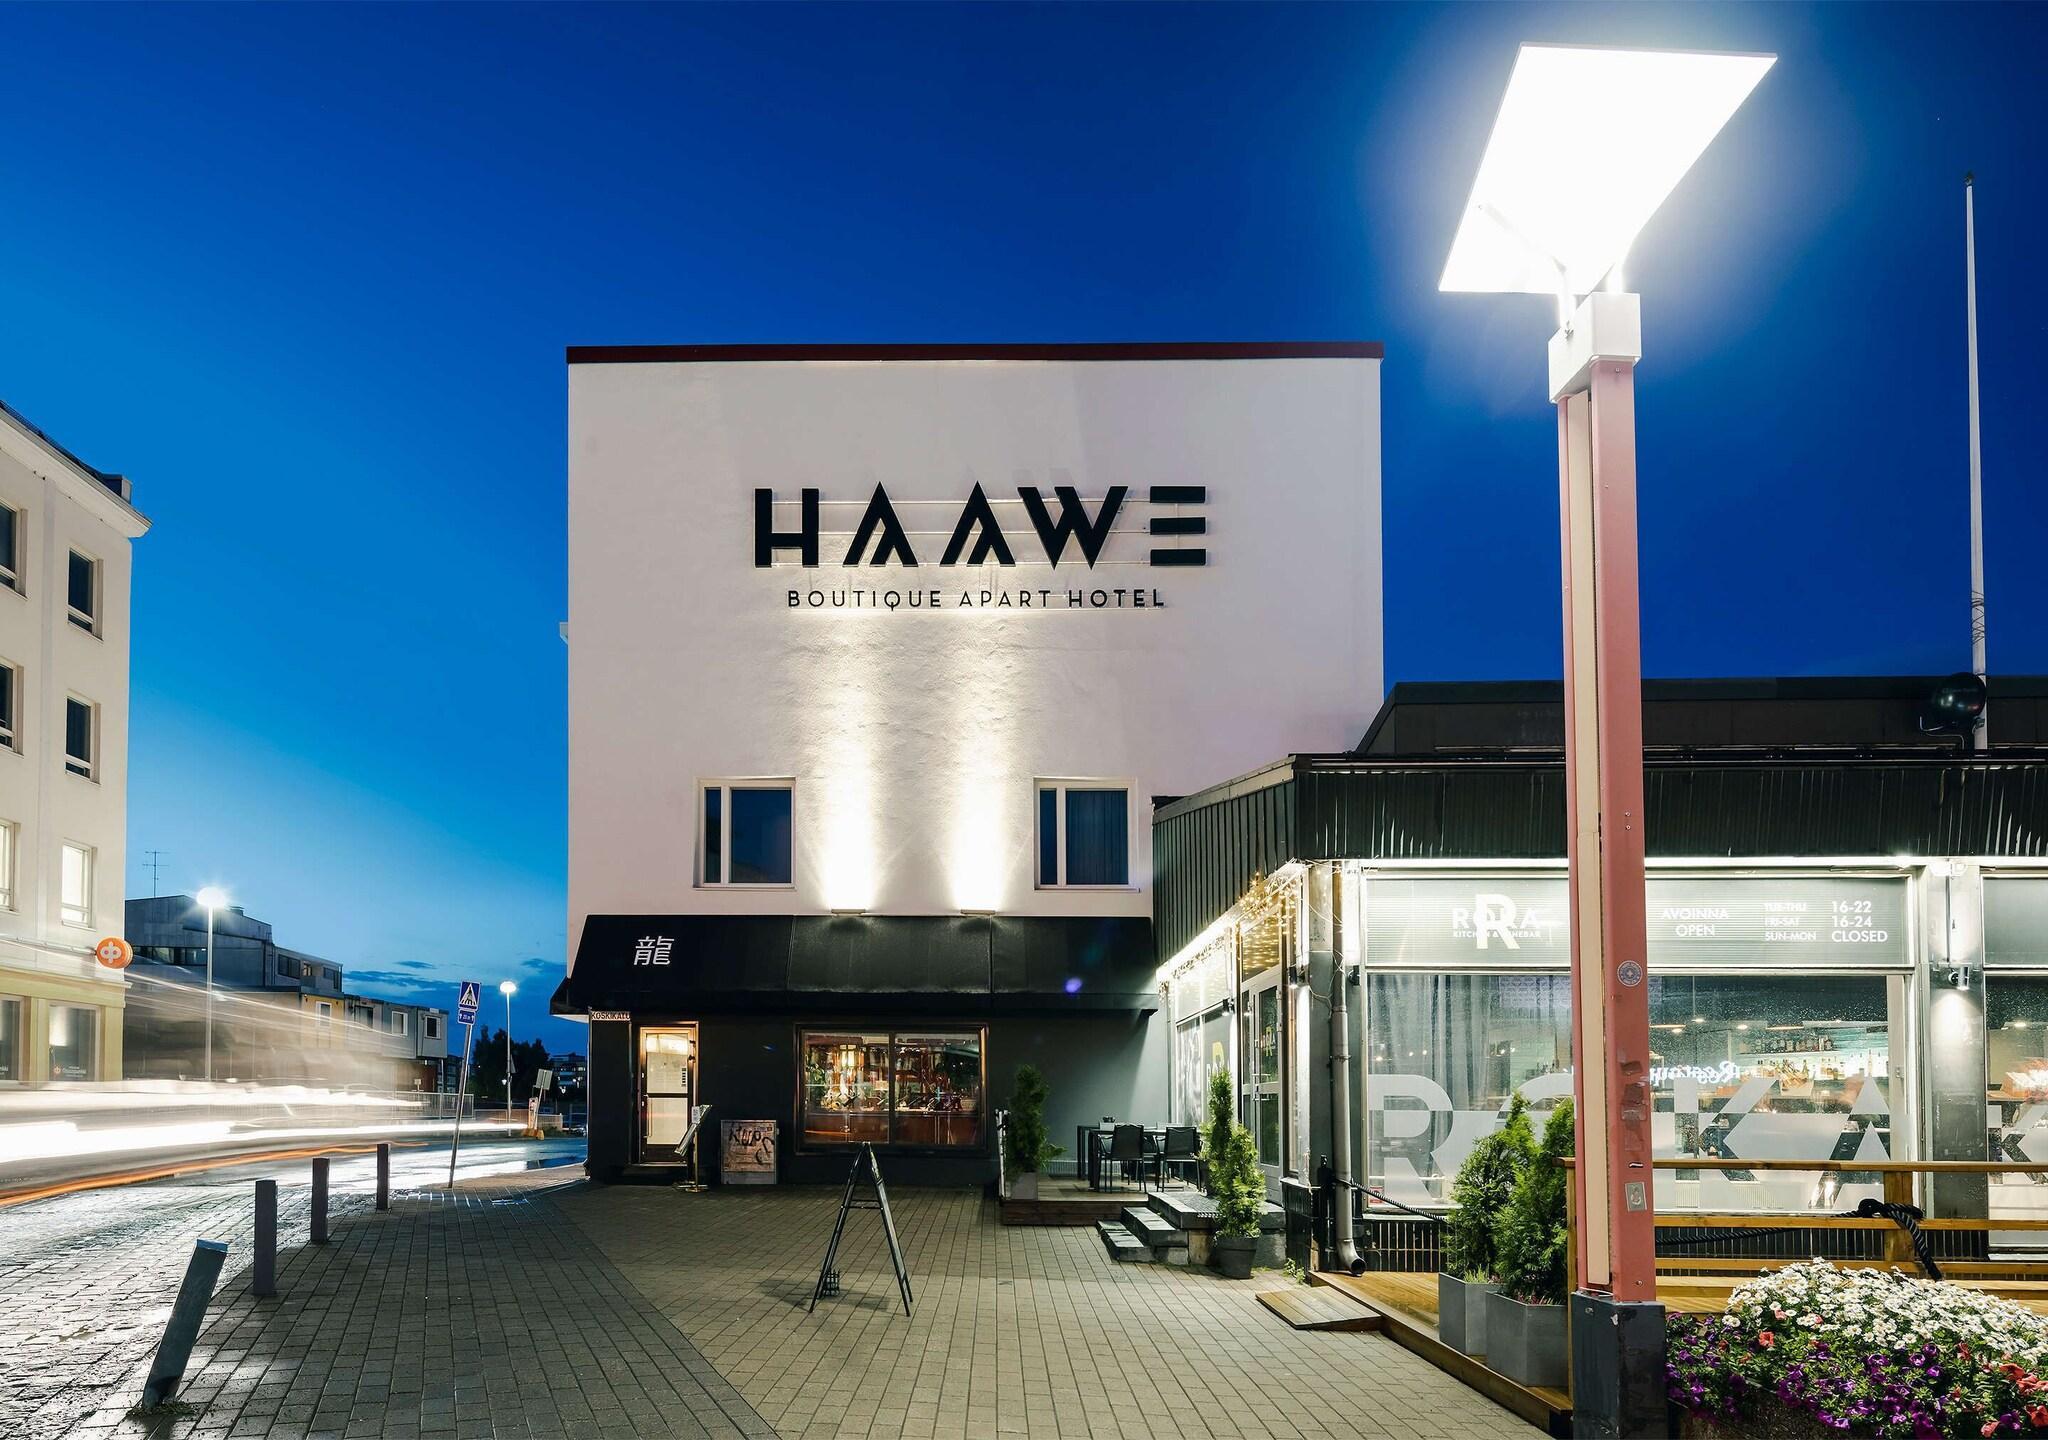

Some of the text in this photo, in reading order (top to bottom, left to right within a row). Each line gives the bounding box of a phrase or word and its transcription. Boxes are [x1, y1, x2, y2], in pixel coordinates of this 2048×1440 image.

[755, 481, 1206, 571] HAAWE
[788, 588, 1164, 611] BOUTIQUE APART HOTEL
[1831, 901, 1872, 913] 16-22
[1662, 908, 1729, 920] AVOINNA
[1831, 916, 1873, 928] 16-24
[1675, 924, 1715, 937] OPEN
[1764, 930, 1888, 942] SUN-MON CLOSED
[633, 935, 675, 966] 龍
[591, 1011, 630, 1020] KOSKIKATU
[1368, 1073, 1890, 1208] RKA
